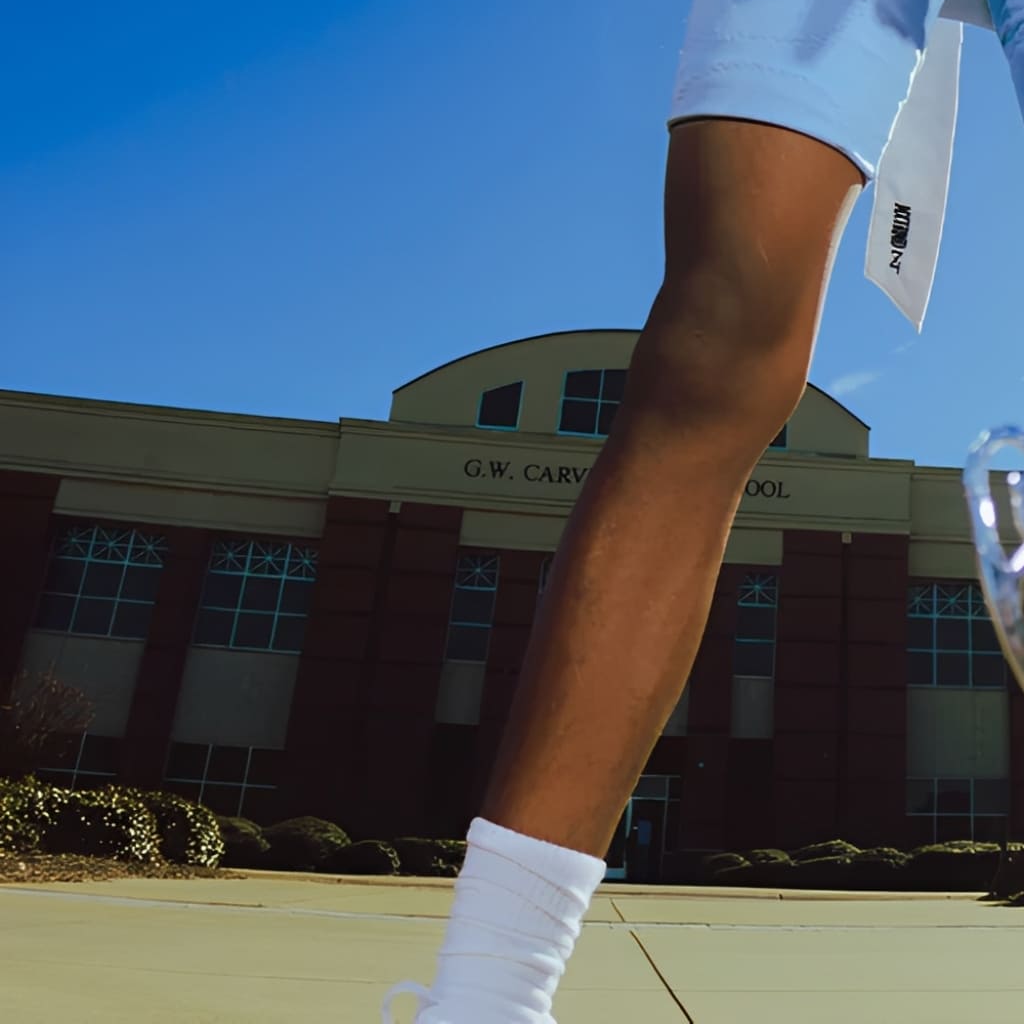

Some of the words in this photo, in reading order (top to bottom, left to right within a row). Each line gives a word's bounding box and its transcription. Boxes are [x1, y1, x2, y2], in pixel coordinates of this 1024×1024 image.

[464, 459, 514, 480] G.W.
[523, 464, 593, 484] CARV
[745, 479, 791, 499] OOL
